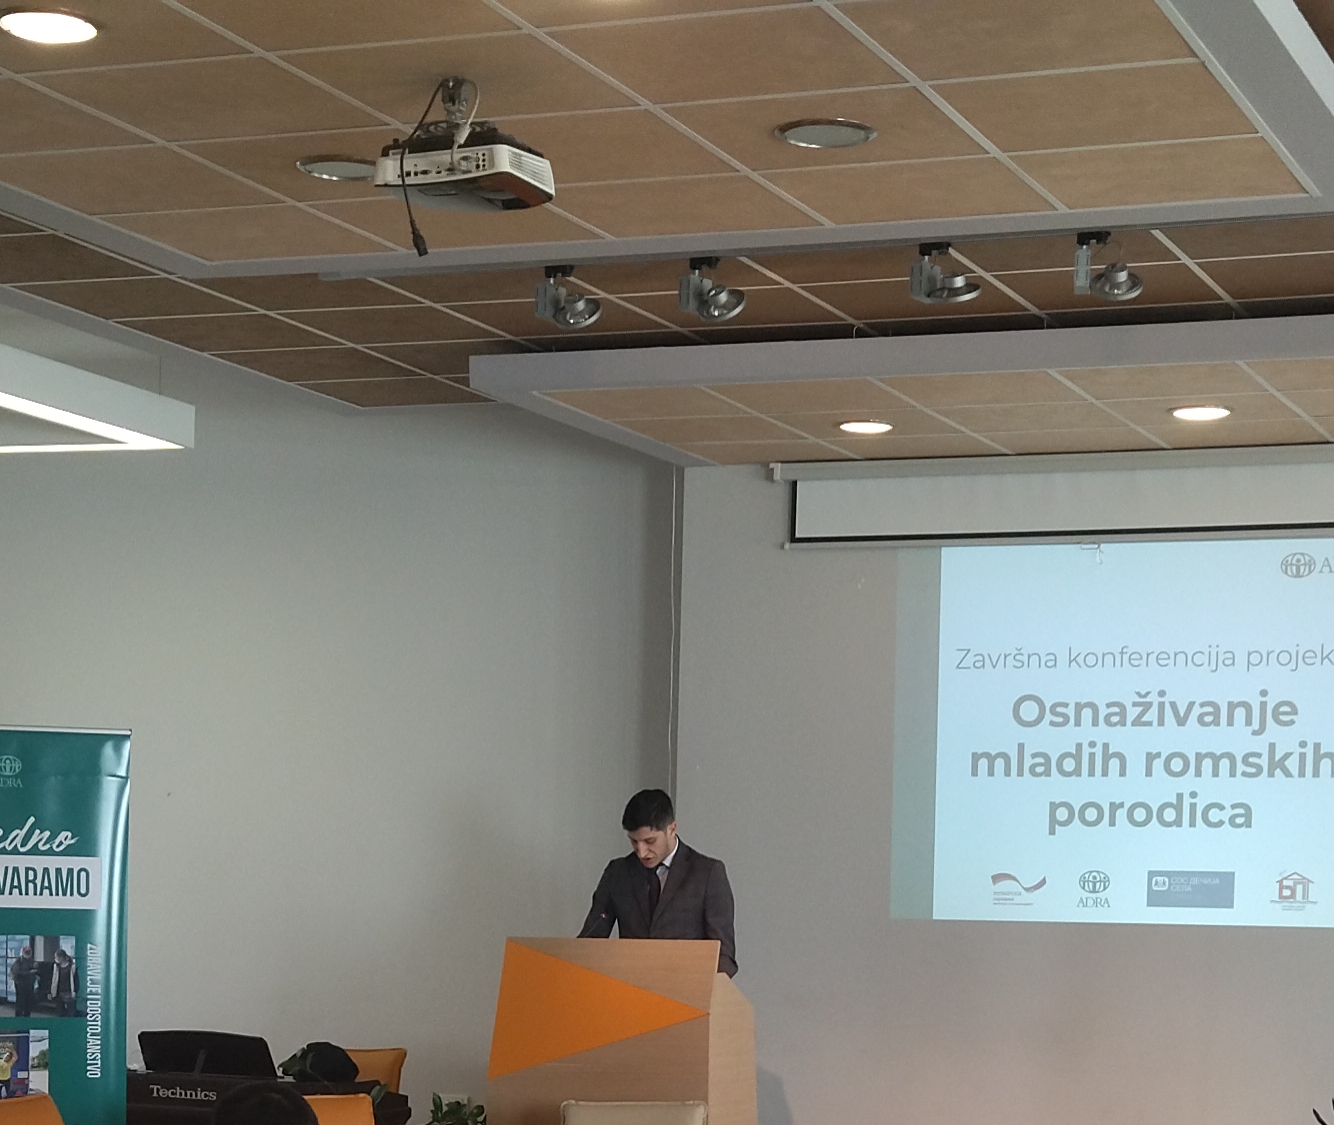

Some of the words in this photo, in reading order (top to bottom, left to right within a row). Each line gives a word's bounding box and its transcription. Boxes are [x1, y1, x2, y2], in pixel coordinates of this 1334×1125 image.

[955, 647, 1058, 670] Završna
[1067, 645, 1236, 672] konferencija
[1011, 689, 1300, 736] Osnaživanje
[969, 742, 1127, 778] mladih
[1048, 791, 1254, 836] porodica
[1076, 897, 1111, 908] ADRA
[87, 943, 101, 993] ZDRAVLJE
[87, 1000, 101, 1078] DOSTOJANSTVO
[149, 1084, 217, 1101] Technics
